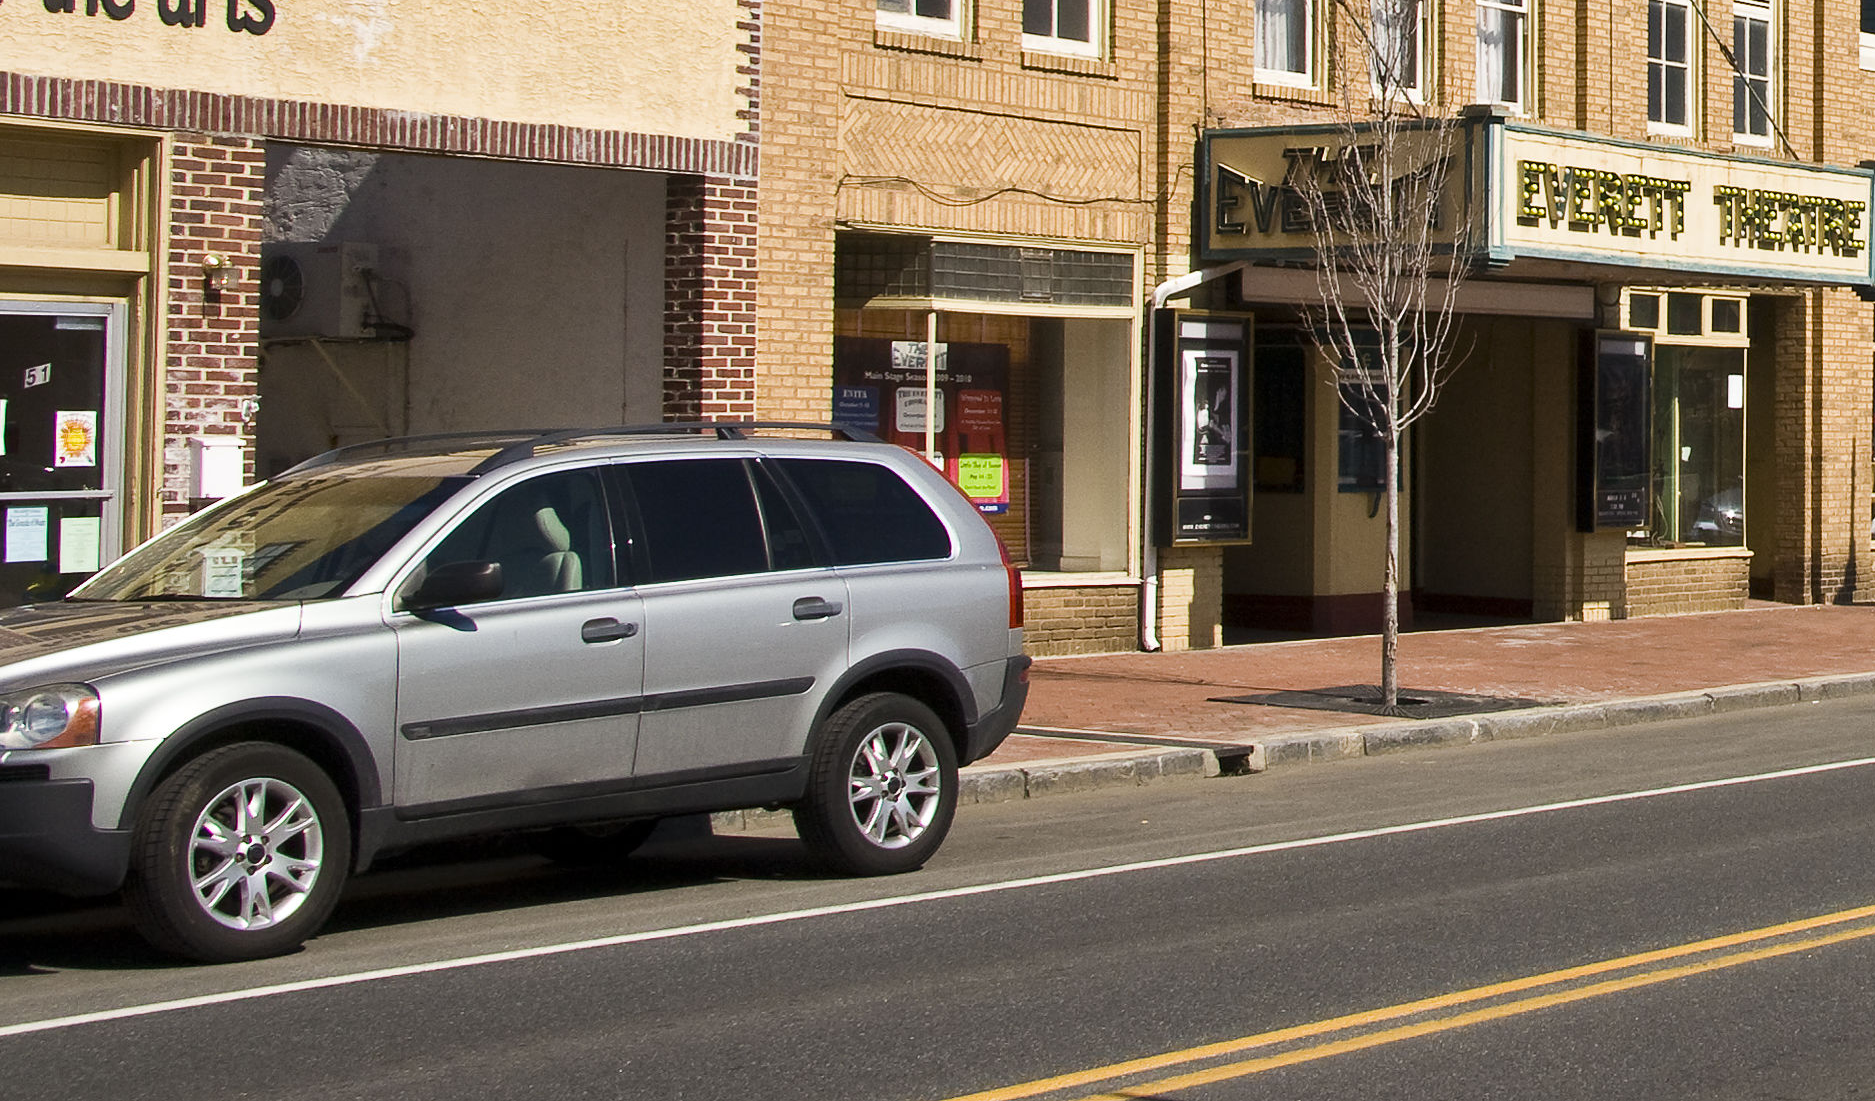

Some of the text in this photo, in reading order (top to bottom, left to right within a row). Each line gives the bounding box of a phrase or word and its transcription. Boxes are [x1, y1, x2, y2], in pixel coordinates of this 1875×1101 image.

[1516, 159, 1866, 258] EVERETT THEATRE
[26, 365, 49, 387] 51
[884, 371, 904, 382] Stage
